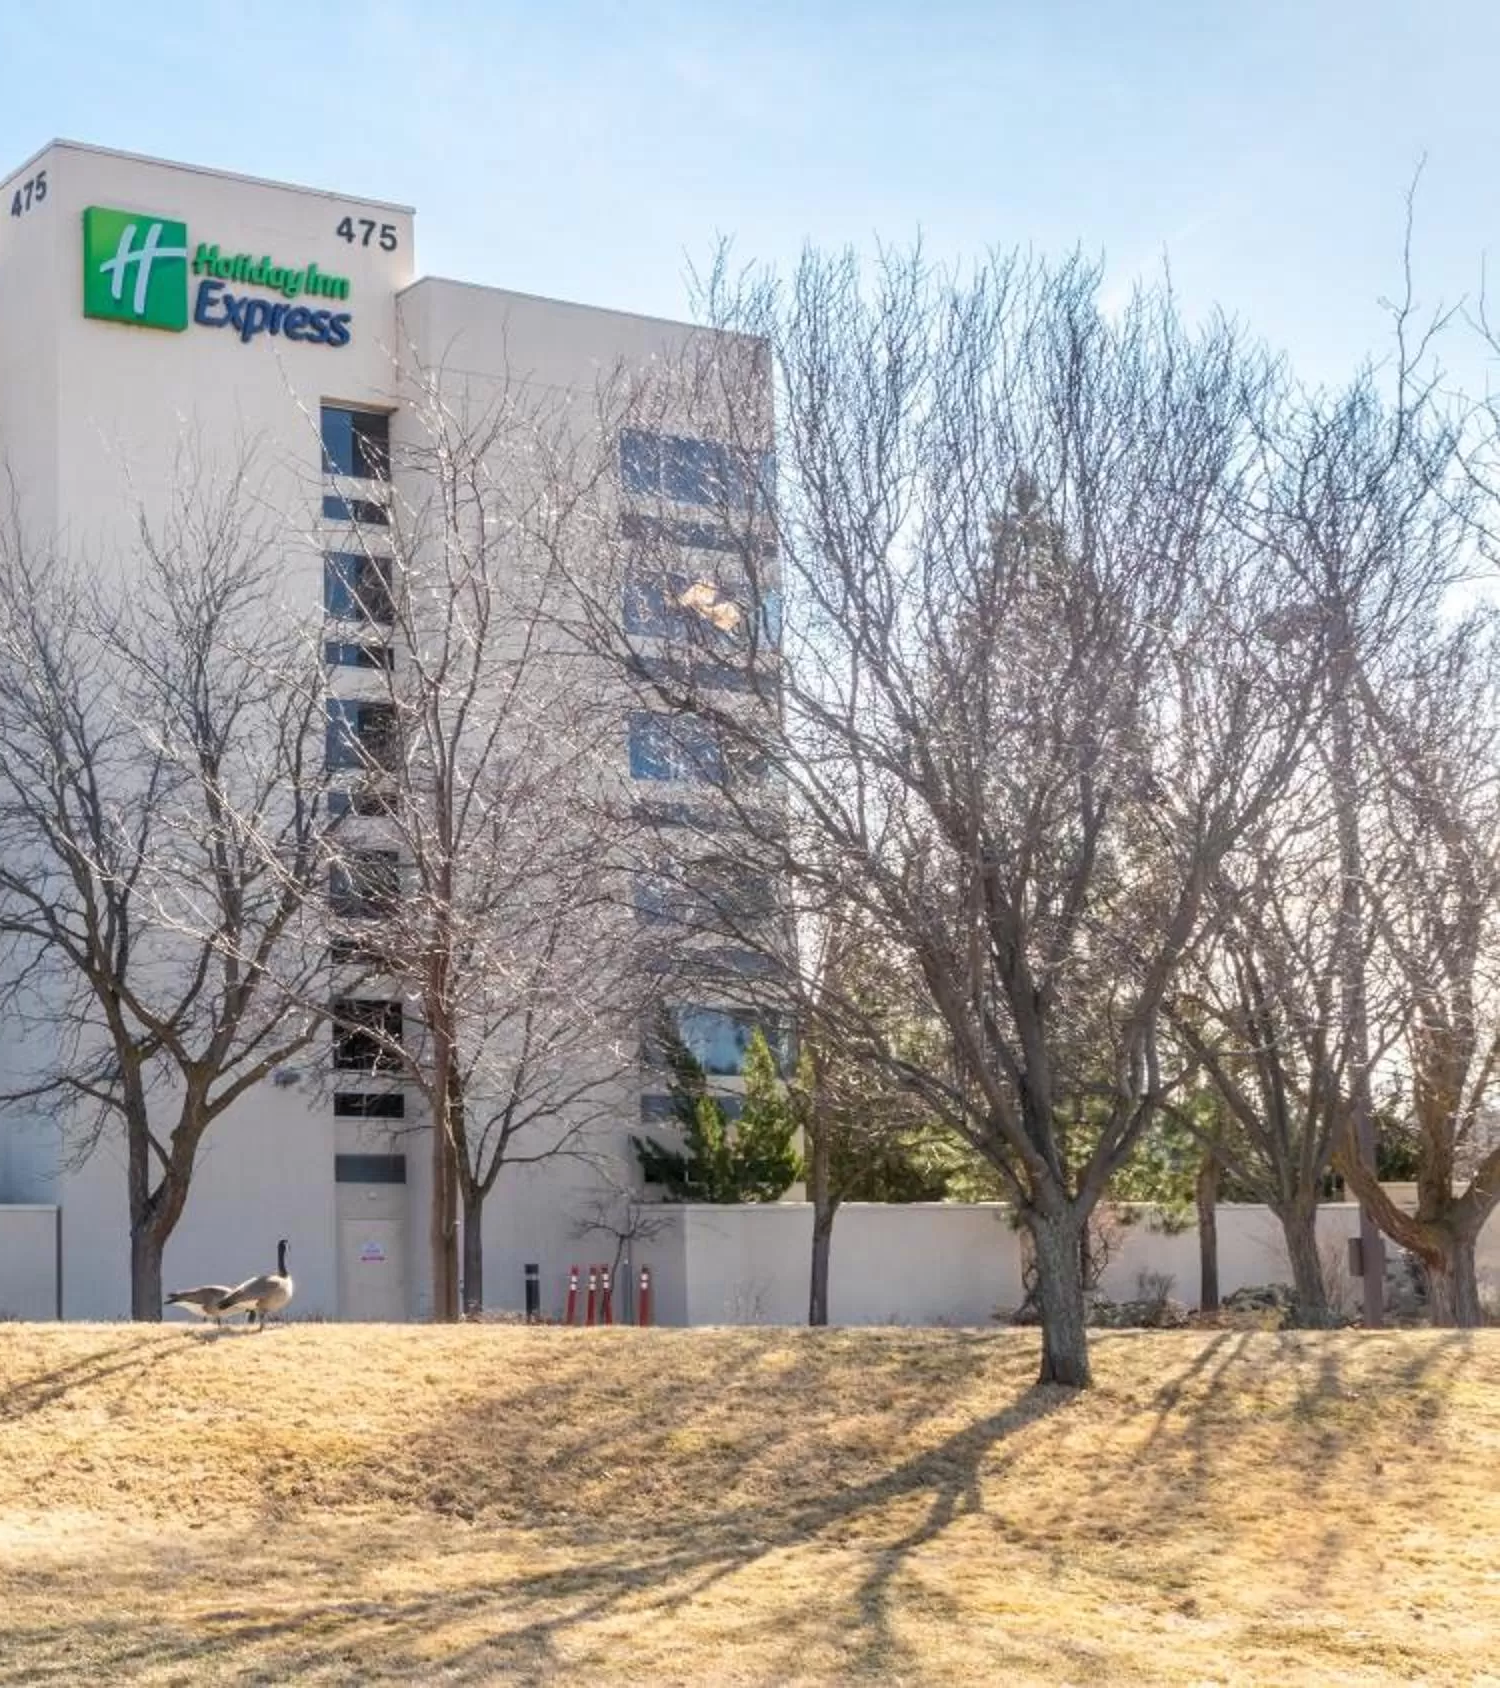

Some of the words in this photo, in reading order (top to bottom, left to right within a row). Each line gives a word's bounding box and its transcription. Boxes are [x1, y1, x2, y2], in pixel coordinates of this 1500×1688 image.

[11, 170, 47, 217] 475
[337, 216, 398, 252] 475
[192, 243, 304, 298] Holiday
[304, 262, 350, 300] Inn
[194, 279, 352, 347] Express
